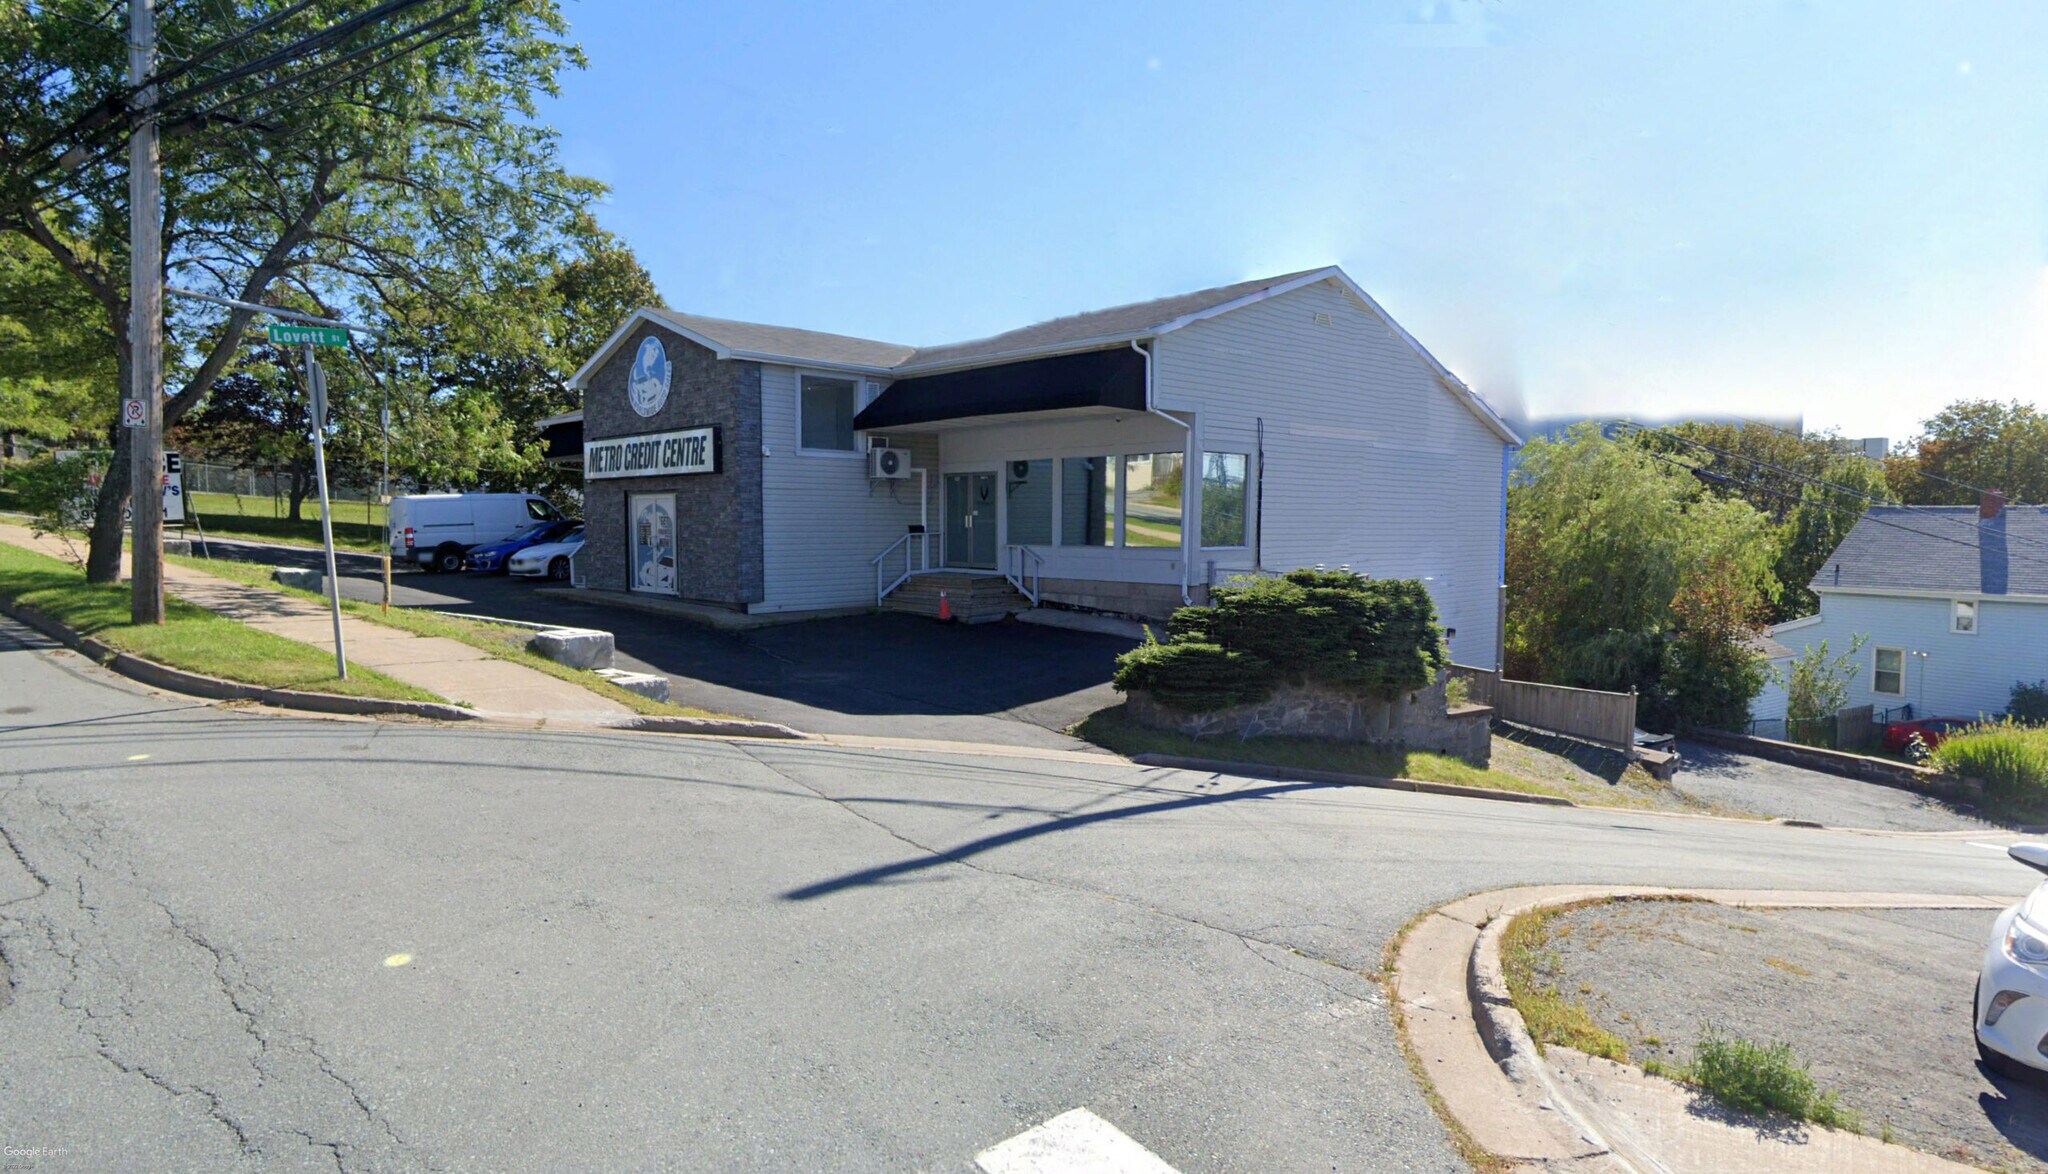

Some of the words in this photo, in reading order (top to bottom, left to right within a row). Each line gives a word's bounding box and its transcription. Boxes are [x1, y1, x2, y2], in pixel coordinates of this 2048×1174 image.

[273, 329, 325, 343] Lovett
[589, 444, 622, 473] METRO
[624, 440, 661, 471] CREDIT
[663, 435, 707, 468] CENTRE
